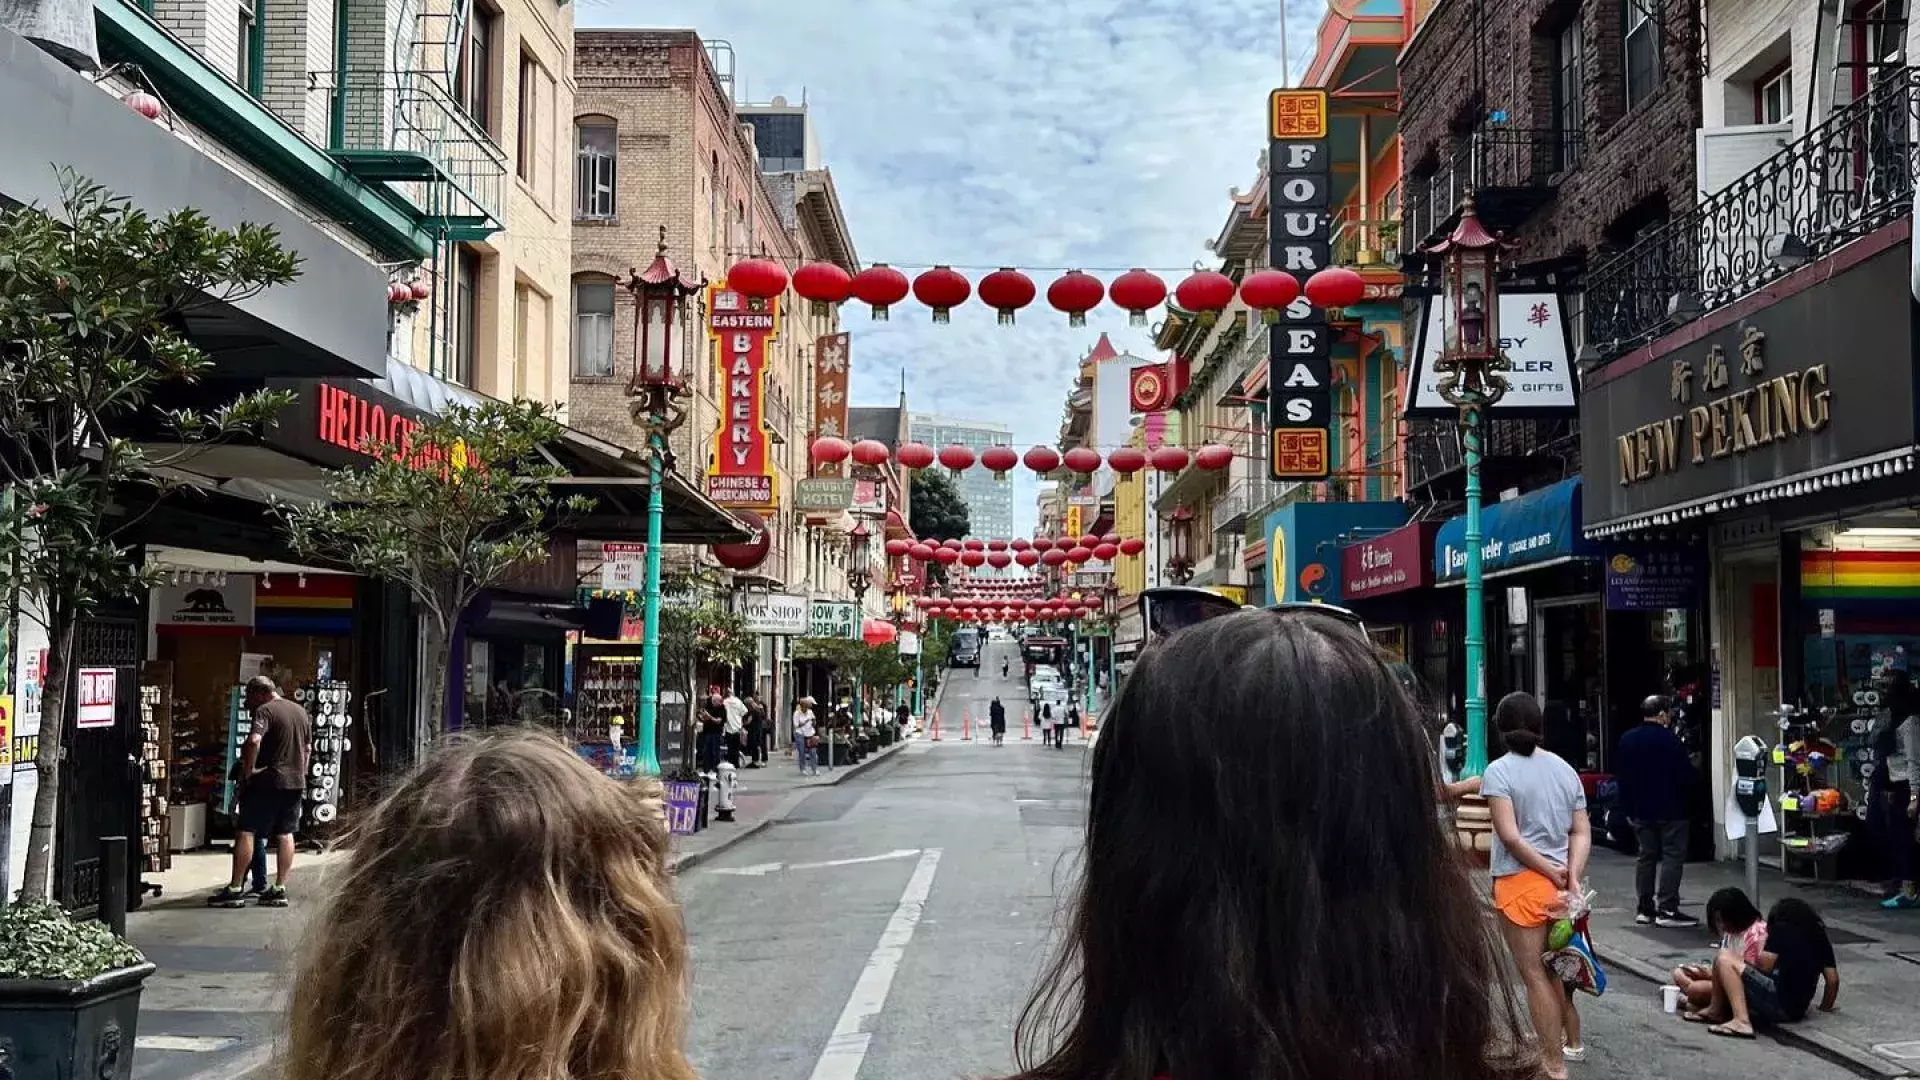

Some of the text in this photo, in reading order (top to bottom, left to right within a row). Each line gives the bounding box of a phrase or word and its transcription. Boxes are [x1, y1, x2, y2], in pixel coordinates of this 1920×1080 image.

[1283, 144, 1317, 270] FOUR
[712, 315, 773, 327] EASTERN
[1528, 302, 1550, 328] 華
[1284, 296, 1319, 422] SEAS
[1671, 327, 1765, 404] 新北京
[1522, 384, 1564, 392] GIFTS
[732, 333, 753, 465] BAKERY
[320, 383, 386, 461] HELLO
[1616, 363, 1831, 486] NEW PEKING
[711, 477, 770, 488] CHINESE &
[711, 488, 770, 501] AMERICAN FOOD
[803, 494, 845, 505] HOTEL
[604, 552, 616, 562] NO
[1452, 549, 1469, 571] Easy
[615, 573, 631, 581] TIME
[616, 564, 631, 572] ANY
[740, 603, 802, 620] WOK SHOP
[81, 674, 113, 705] FOR RENT
